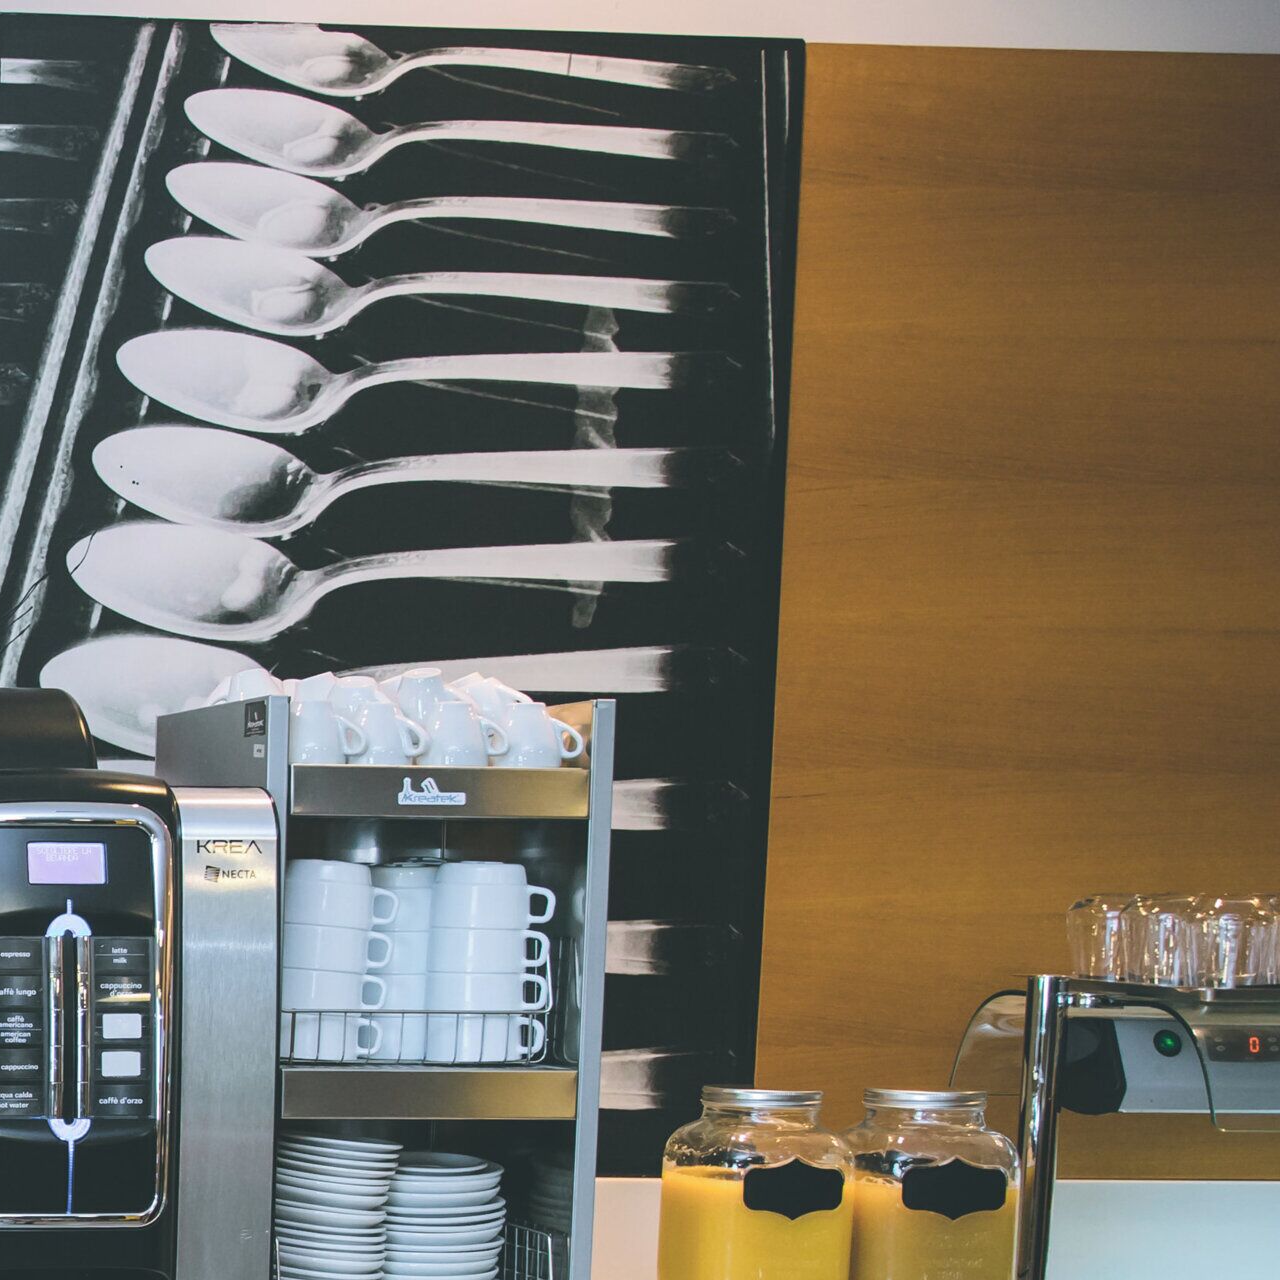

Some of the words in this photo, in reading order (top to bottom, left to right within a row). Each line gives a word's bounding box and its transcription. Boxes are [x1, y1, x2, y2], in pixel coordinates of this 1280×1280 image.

[197, 839, 262, 854] KREA
[222, 870, 256, 879] NECTA
[100, 982, 143, 990] cappuccino
[15, 988, 37, 997] lungo
[7, 1015, 25, 1023] caffè
[1249, 1036, 1260, 1053] 0
[99, 1096, 119, 1104] caffè
[119, 1096, 143, 1104] d'orzo
